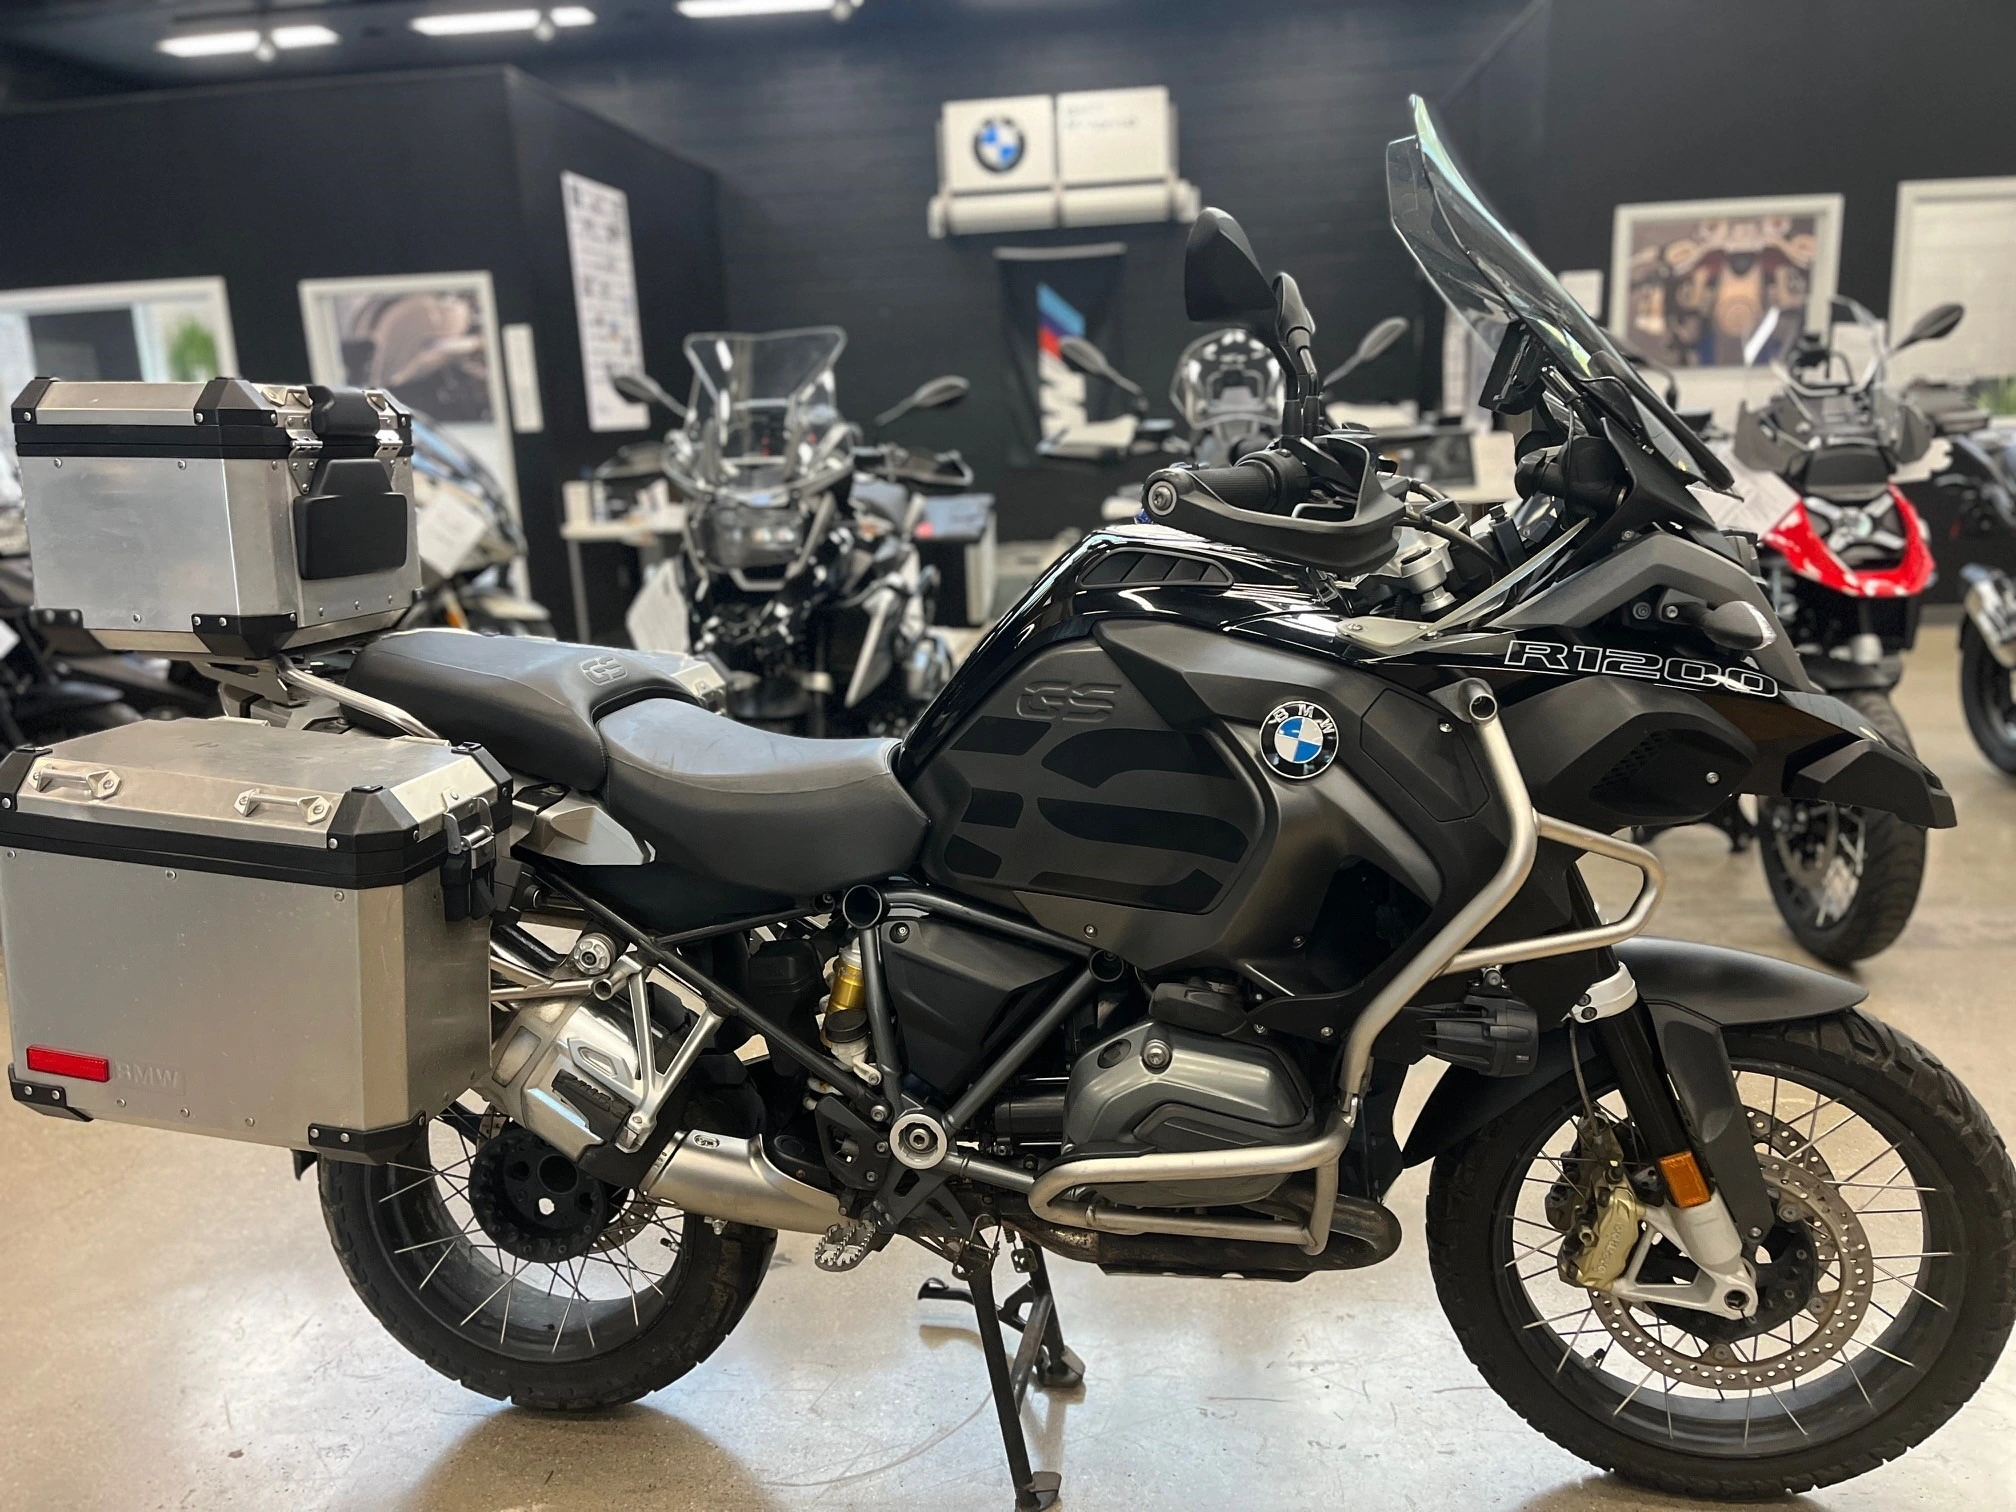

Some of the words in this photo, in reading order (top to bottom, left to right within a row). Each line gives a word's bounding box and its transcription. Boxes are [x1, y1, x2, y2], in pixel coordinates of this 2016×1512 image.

[580, 655, 628, 685] GS
[1503, 639, 1779, 697] R1200
[1016, 680, 1121, 722] GS
[1272, 703, 1335, 734] BMW
[117, 1061, 179, 1089] BMW
[1593, 1221, 1625, 1275] brembo
